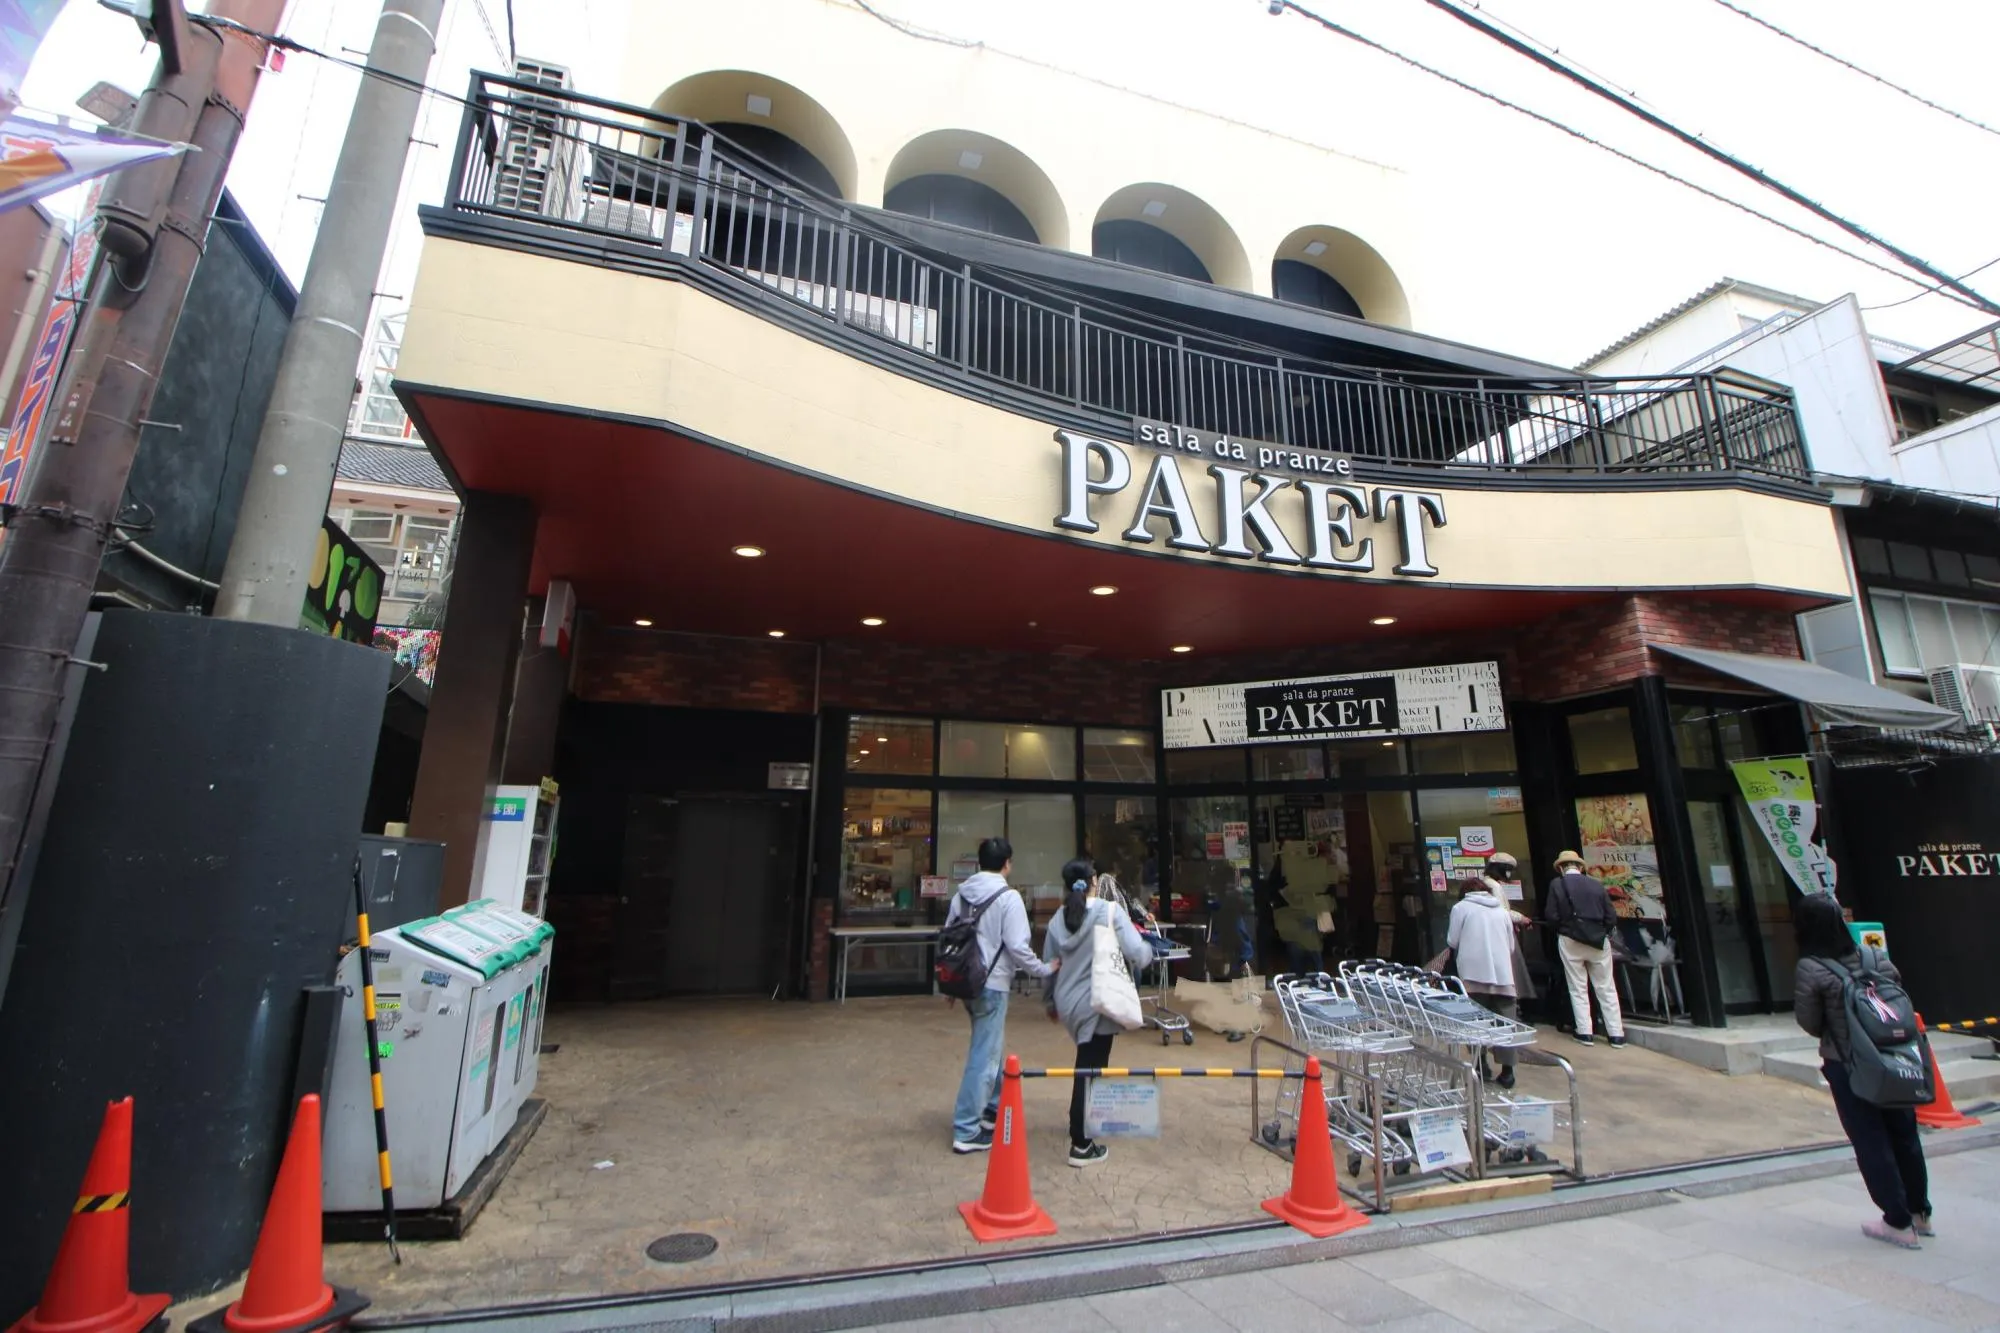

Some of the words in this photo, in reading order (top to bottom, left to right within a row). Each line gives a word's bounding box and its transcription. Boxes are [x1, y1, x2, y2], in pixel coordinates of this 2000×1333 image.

[1140, 424, 1202, 452] sala
[1215, 435, 1246, 460] da
[1258, 447, 1350, 475] pranze
[1053, 428, 1447, 577] PAKET
[1283, 689, 1304, 701] sala
[1307, 688, 1319, 699] da
[1321, 686, 1354, 700] pranze
[1256, 697, 1387, 732] PAKET
[1467, 835, 1487, 843] CGC
[1917, 843, 1937, 852] sala
[1939, 843, 1950, 852] da
[1951, 843, 1981, 852] pranze
